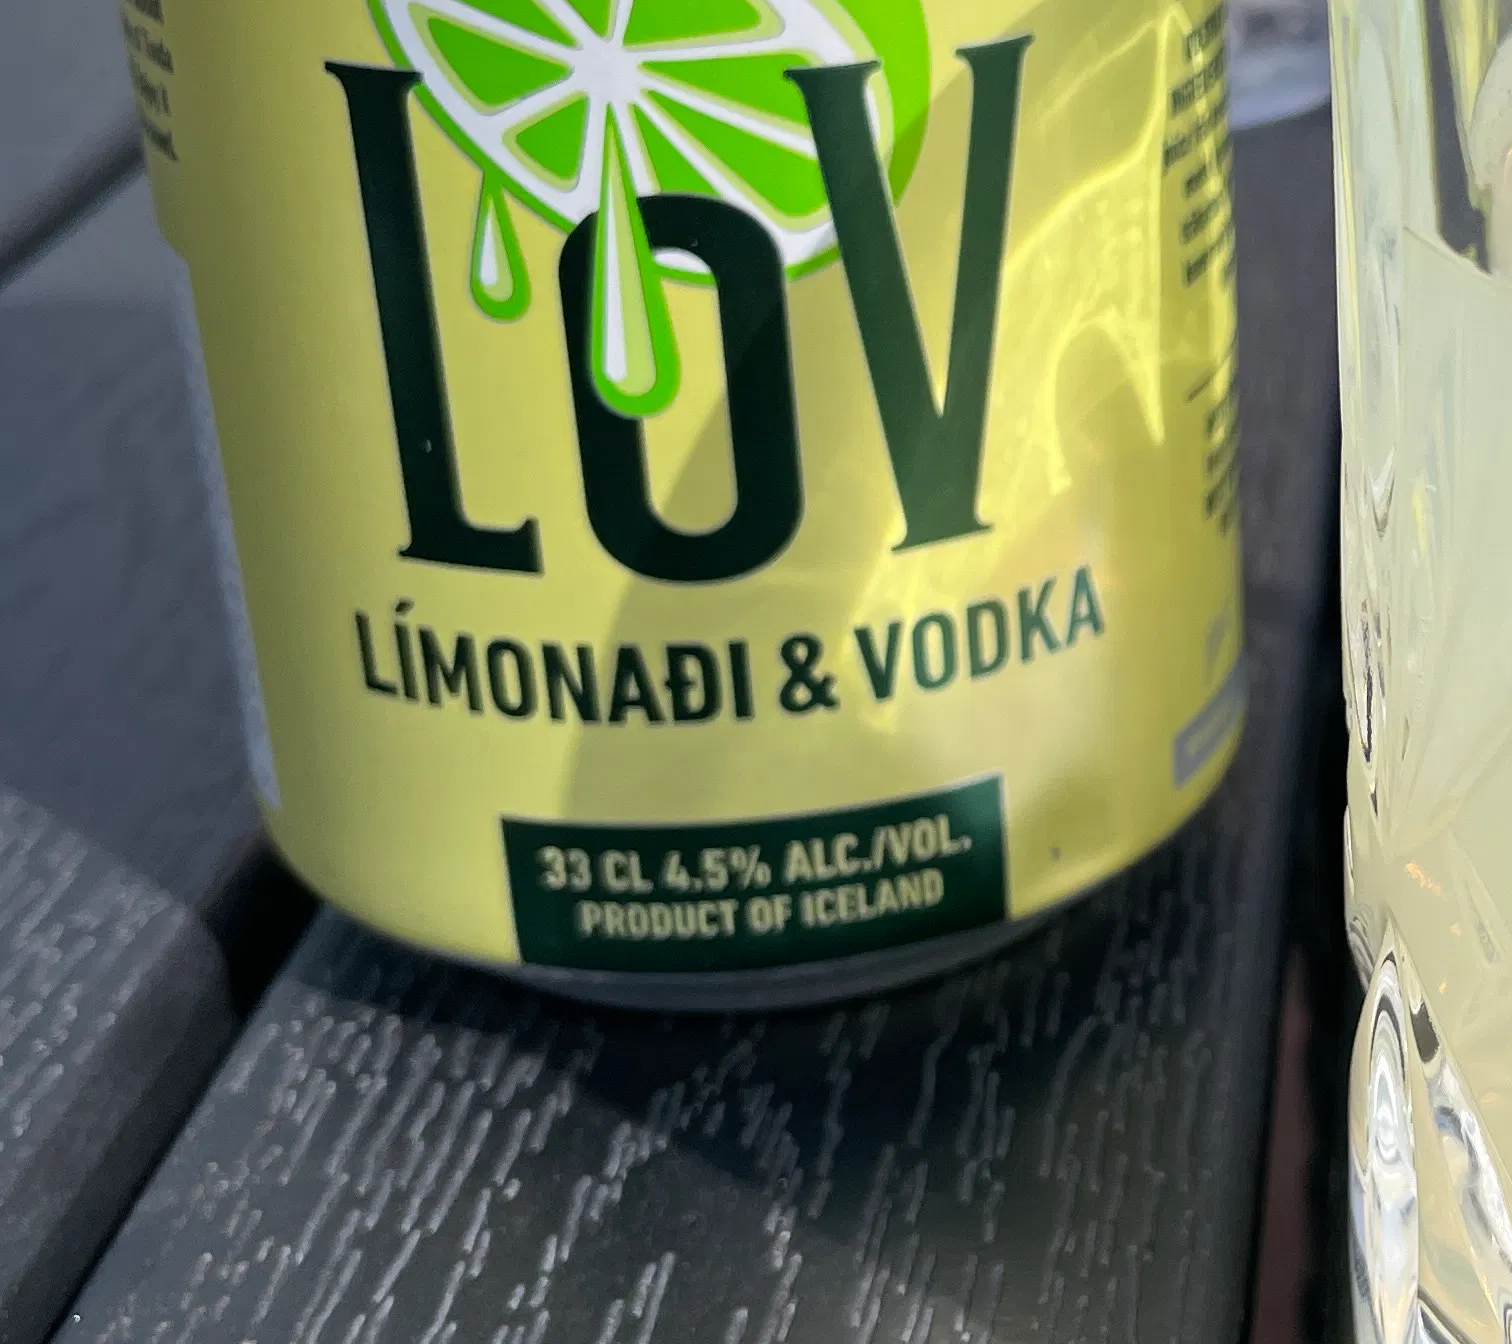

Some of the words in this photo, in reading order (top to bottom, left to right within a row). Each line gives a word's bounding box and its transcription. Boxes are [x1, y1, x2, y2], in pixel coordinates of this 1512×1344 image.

[325, 34, 1033, 584] LOV
[355, 599, 754, 725] LÍMONAÐI
[780, 633, 839, 714] &
[853, 565, 1105, 700] VODKA
[537, 845, 592, 891] 33
[603, 850, 654, 894] CL
[663, 845, 772, 892] 4.5%
[783, 813, 973, 884] ALC./VOL.
[577, 898, 737, 939] PRODUCT
[747, 894, 792, 932] OF
[802, 867, 945, 929] ICELAND
